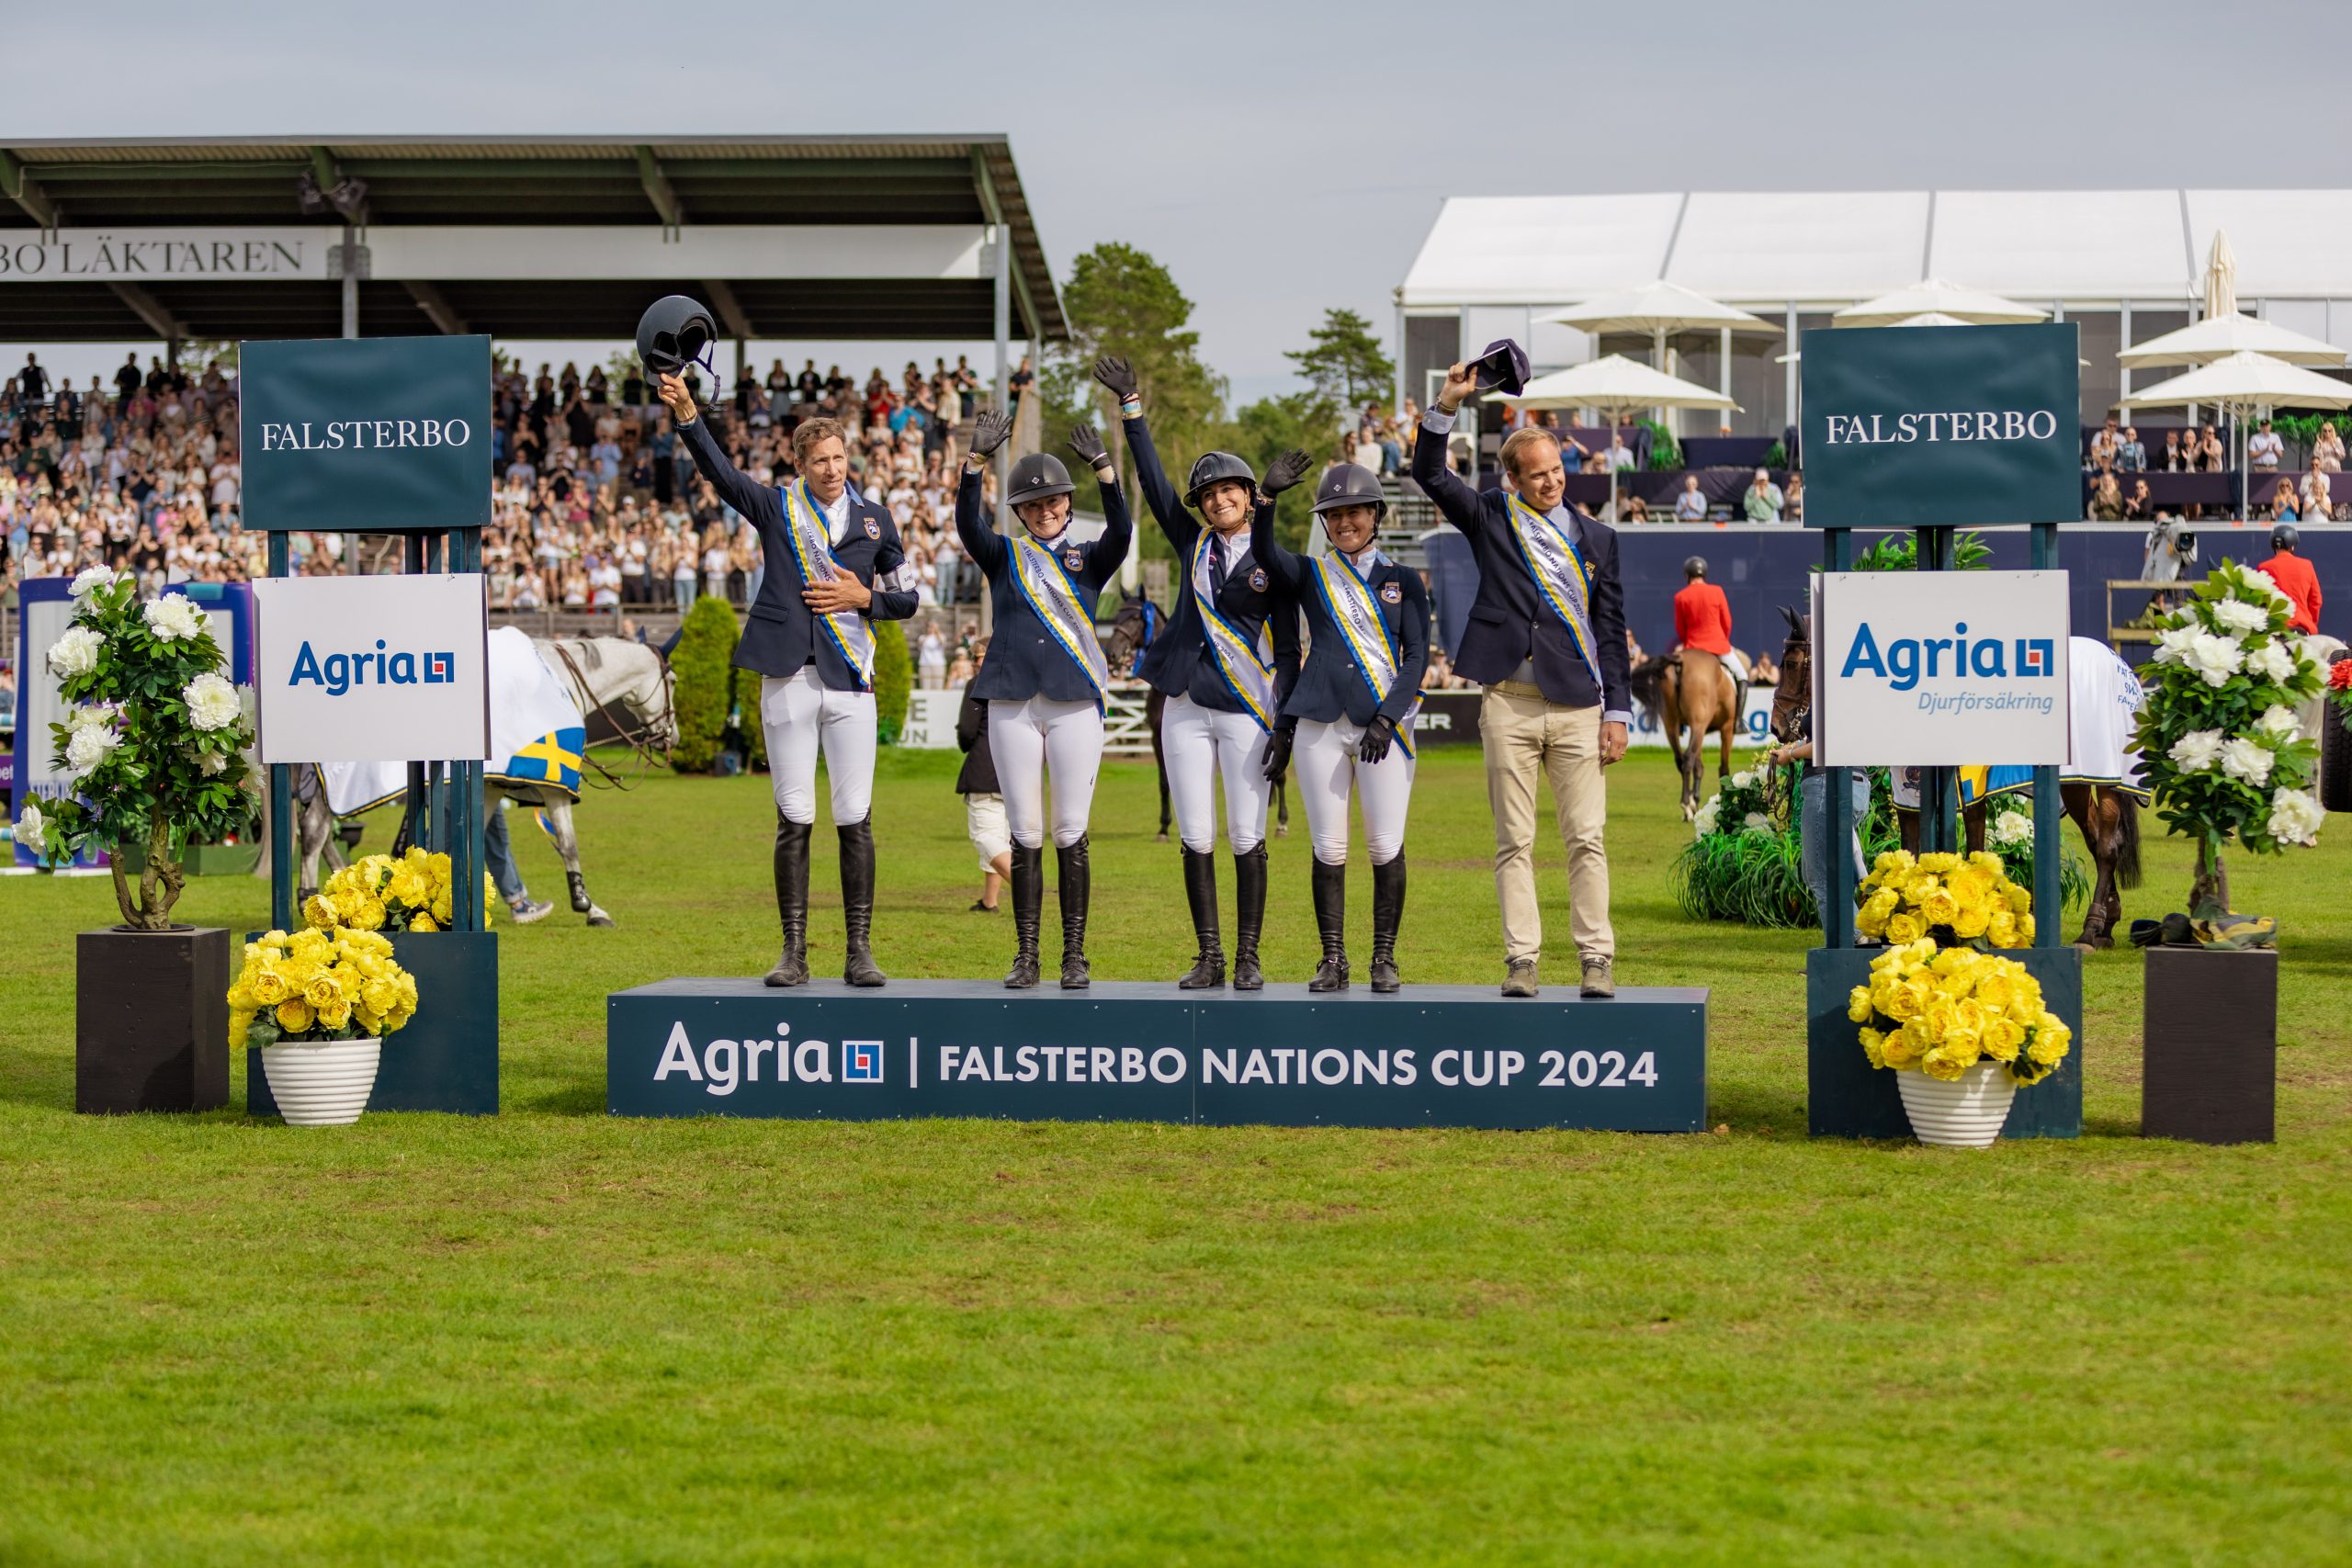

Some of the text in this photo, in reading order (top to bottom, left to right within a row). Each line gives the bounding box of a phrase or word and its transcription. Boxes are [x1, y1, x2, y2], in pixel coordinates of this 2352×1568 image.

[61, 235, 304, 274] LÄKTAREN
[261, 419, 470, 451] FALSTERBO
[1825, 410, 2057, 445] FALSTERBO
[815, 551, 832, 581] NATIONS
[1024, 549, 1045, 579] FALSTERBO
[1041, 579, 1064, 607] NATIONS
[1549, 558, 1570, 589] NATIONS
[1567, 588, 1578, 606] CUP
[288, 638, 418, 696] Agria
[1840, 622, 2007, 692] Agria
[1917, 691, 2054, 716] Djurförsäkring
[653, 1021, 1659, 1096] Agria FALSTERBO NATIONS CUP 2024
